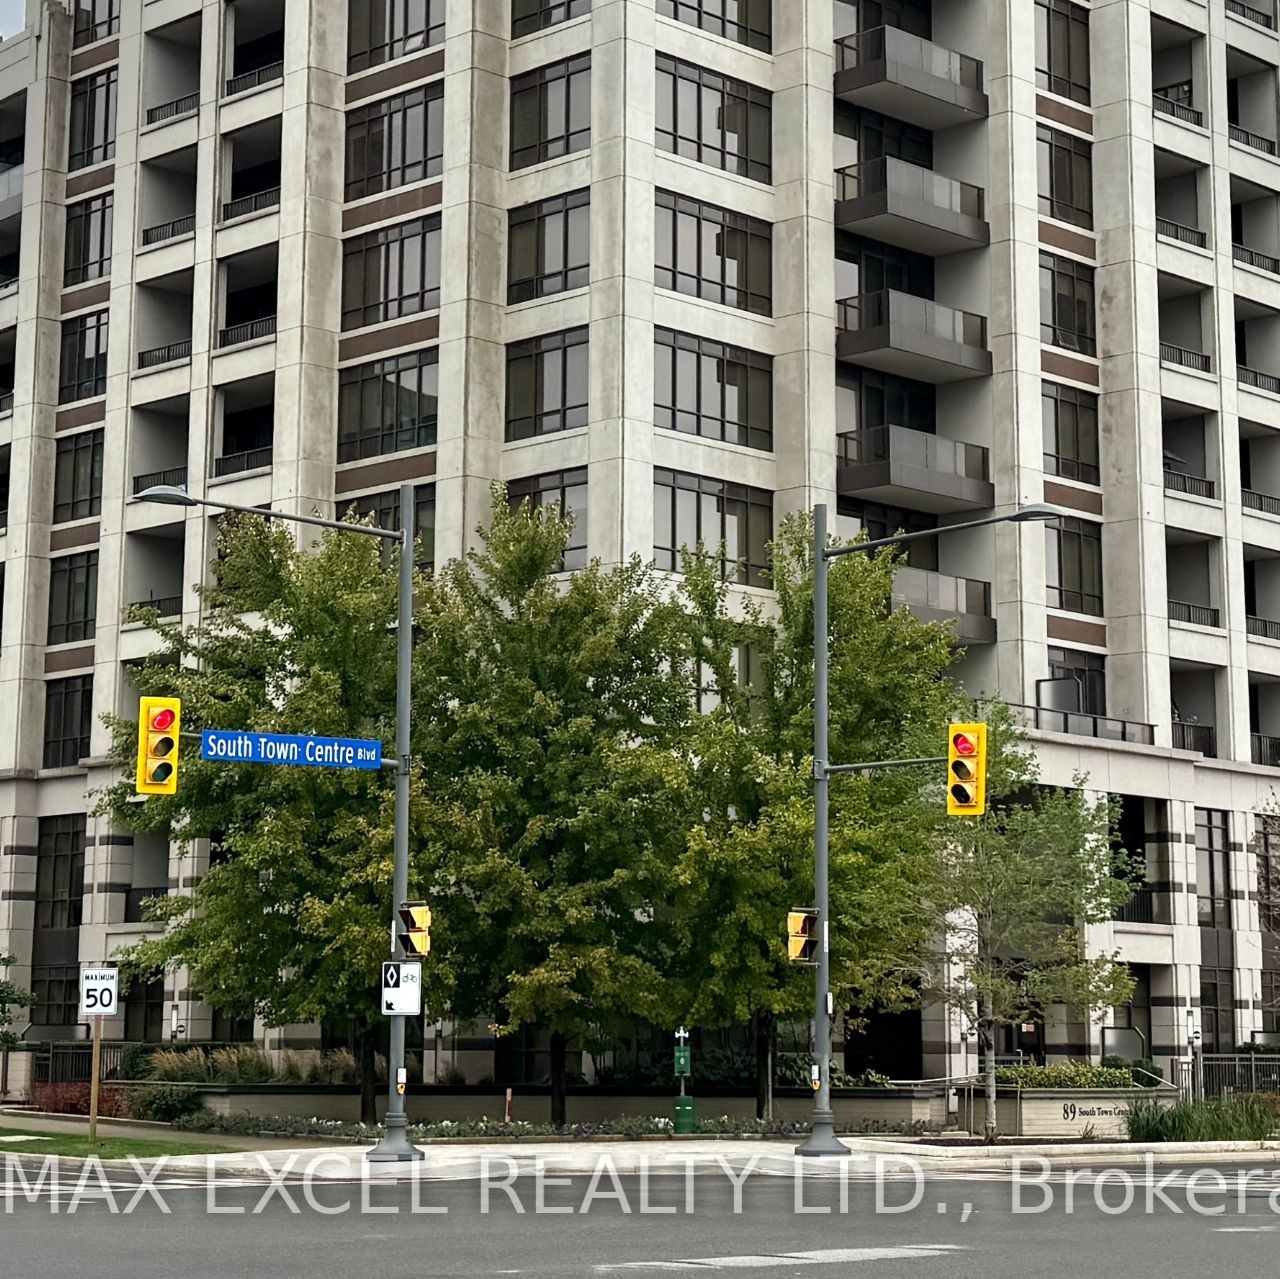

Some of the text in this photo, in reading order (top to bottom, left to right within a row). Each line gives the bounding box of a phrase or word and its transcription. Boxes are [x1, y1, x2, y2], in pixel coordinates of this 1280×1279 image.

[208, 734, 376, 764] South Town Centre Blvd
[86, 988, 113, 1008] 50
[1063, 1103, 1076, 1121] 89
[1079, 1107, 1096, 1117] South
[1097, 1107, 1113, 1116] Town
